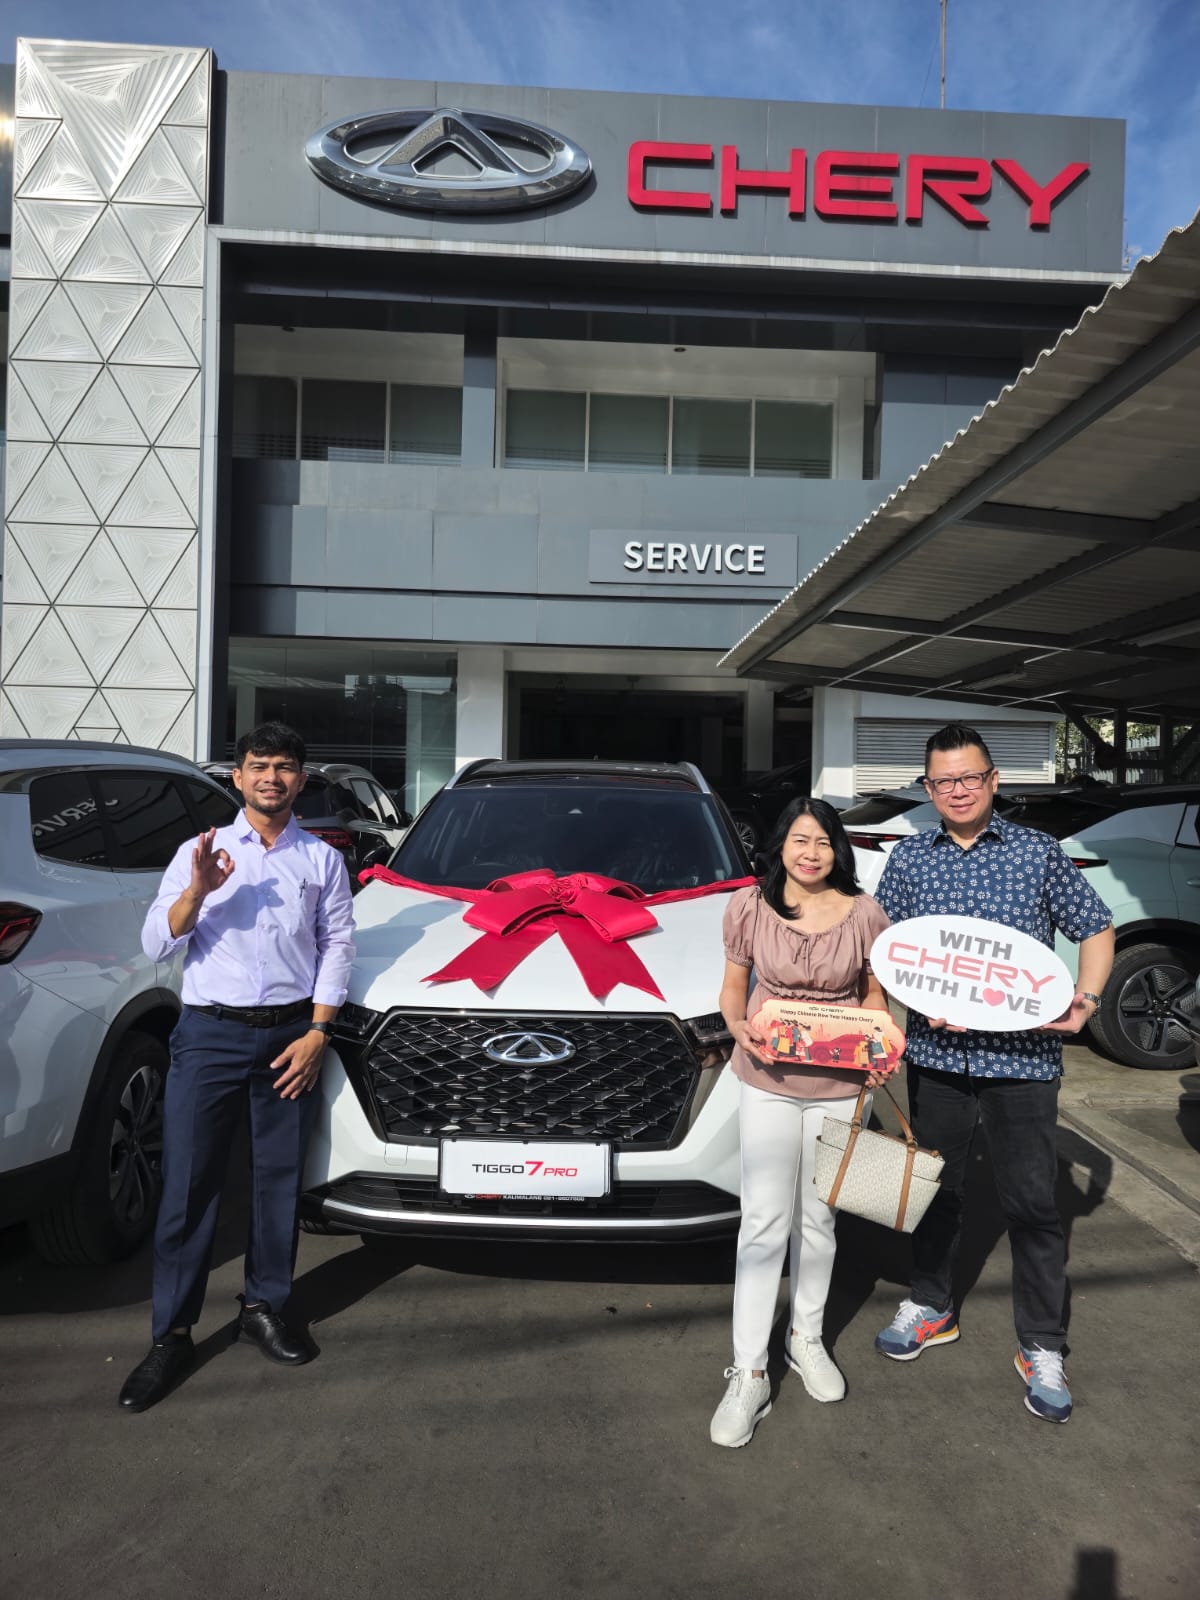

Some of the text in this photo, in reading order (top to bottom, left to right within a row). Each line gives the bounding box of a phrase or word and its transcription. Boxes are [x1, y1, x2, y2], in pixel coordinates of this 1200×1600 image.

[627, 141, 1090, 230] CHERY
[623, 541, 766, 574] SERVICE
[940, 929, 1013, 961] WITH
[887, 941, 1056, 993] CHERY
[895, 969, 960, 998] WITH
[780, 1008, 796, 1016] Happy
[858, 1015, 874, 1023] Chery
[472, 1160, 578, 1177] TIGGO 7 PRO
